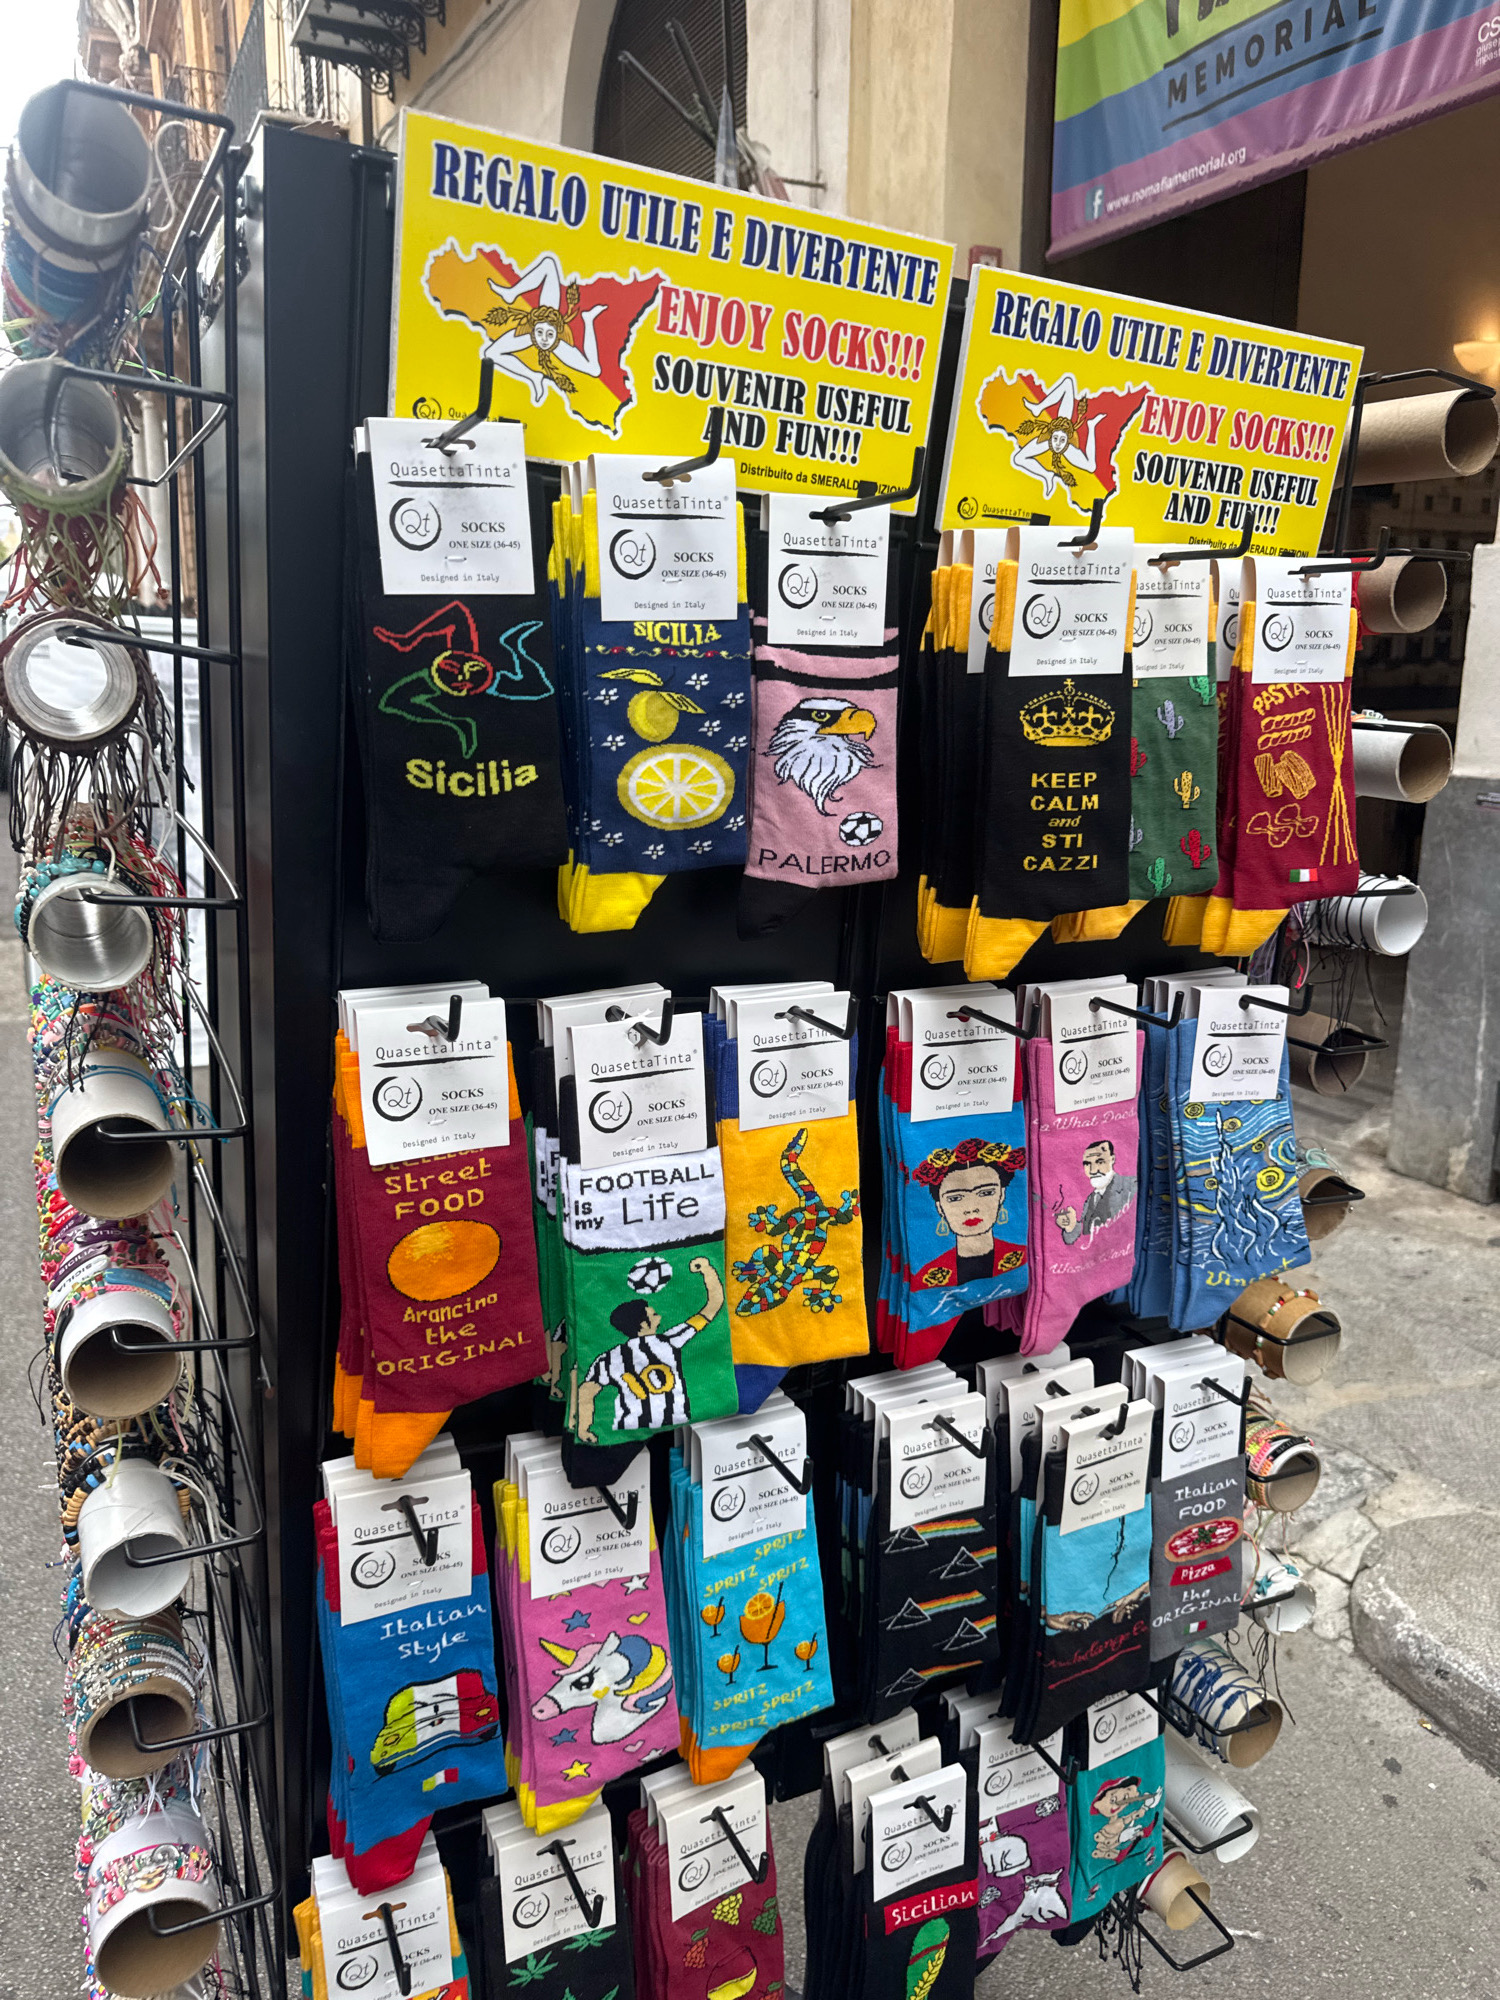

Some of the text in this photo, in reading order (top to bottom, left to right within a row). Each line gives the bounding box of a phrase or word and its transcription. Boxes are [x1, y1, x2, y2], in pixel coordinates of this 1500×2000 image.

[1168, 0, 1377, 109] MEMORIAL
[1106, 146, 1247, 213] www.nomafiamemorial.org
[432, 142, 940, 306] REGALO UTILE E DIVERTENTE
[656, 287, 926, 381] ENJOY SOCKS!!!
[991, 290, 1351, 401] REGALO UTILE E DIVERTENTE
[653, 354, 912, 433] SOUVENIR USEFUL
[1139, 395, 1335, 463] ENJOY SOCKS!!!
[776, 418, 862, 465] FUN!!!
[740, 462, 793, 480] Distribuito
[796, 471, 808, 483] da
[811, 473, 860, 491] SMERALD
[1133, 451, 1318, 507] SOUVENIR USEFUL
[982, 504, 1030, 517] QuasettaTin
[1163, 491, 1211, 526] AND
[461, 521, 506, 533] SOCKS
[449, 540, 521, 550] ONE SIZE (36-45)
[1248, 543, 1277, 557] ERALDI
[673, 552, 714, 563] SOCKS
[421, 574, 459, 583] Designed
[477, 574, 500, 583] Italy
[661, 570, 727, 579] ONE SIZE (36-45)
[832, 585, 867, 595] SOCKS
[634, 601, 706, 610] Designed in Italy
[821, 601, 837, 609] ONE
[838, 601, 855, 609] SIZE
[1074, 613, 1108, 623] SOCKS
[633, 620, 722, 646] SICILIA
[797, 629, 826, 637] Designed
[840, 629, 858, 637] Italy
[1062, 629, 1077, 637] ONE
[1078, 629, 1095, 637] SIZE
[1304, 629, 1333, 639] SOCKS
[1036, 658, 1066, 666] Designed
[1079, 657, 1098, 665] Italy
[1252, 683, 1310, 717] PASTA
[405, 757, 539, 797] Sicilia
[1031, 772, 1097, 789] KEEP
[1030, 794, 1099, 812] CALM
[1048, 815, 1080, 828] and
[1041, 833, 1083, 849] STI
[758, 848, 892, 876] PALERMO
[1023, 854, 1098, 872] CAZZI
[967, 1065, 998, 1075] SOCKS
[1098, 1057, 1123, 1068] SOCKS
[1242, 1057, 1269, 1065] SOCKS
[801, 1068, 834, 1080] SOCKS
[441, 1088, 484, 1100] SOCKS
[429, 1102, 498, 1115] ONE SIZE (36-45)
[648, 1099, 685, 1112] SOCKS
[637, 1118, 654, 1126] ONE
[655, 1115, 673, 1124] SIZE
[403, 1137, 437, 1148] Designed
[454, 1132, 476, 1140] Italy
[384, 1158, 492, 1195] Street
[579, 1164, 714, 1195] FOOTBALL
[395, 1188, 485, 1220] FOOD
[574, 1199, 592, 1217] is
[575, 1192, 699, 1230] my Life
[403, 1293, 498, 1323] Arancino
[425, 1322, 478, 1345] the
[376, 1331, 532, 1376] ORIGINAL
[621, 1363, 675, 1400] 10
[943, 1466, 972, 1479] SOCKS
[758, 1485, 789, 1500] SOCKS
[1174, 1478, 1238, 1502] Italian
[1179, 1498, 1227, 1520] FOOD
[596, 1529, 632, 1542] SOCKS
[1182, 1588, 1211, 1602] the
[1152, 1593, 1241, 1628] ORIGINAL
[380, 1602, 487, 1640] Italian
[398, 1631, 469, 1663] Style
[892, 1891, 975, 1925] Sicilian
